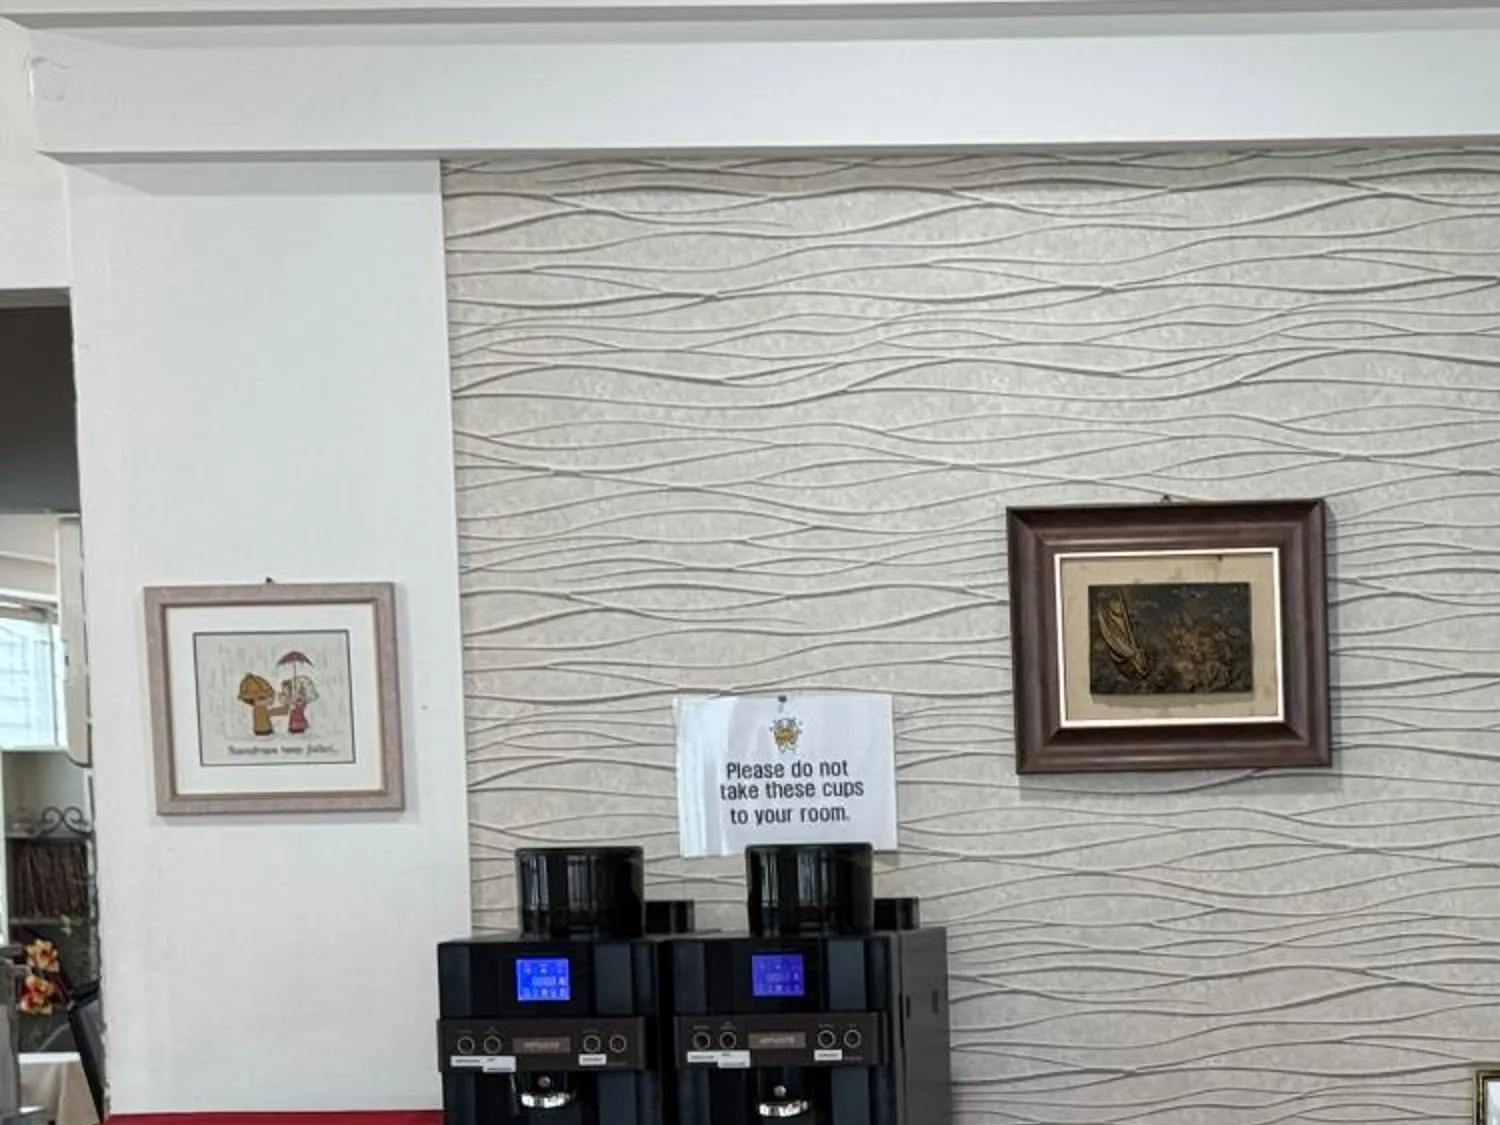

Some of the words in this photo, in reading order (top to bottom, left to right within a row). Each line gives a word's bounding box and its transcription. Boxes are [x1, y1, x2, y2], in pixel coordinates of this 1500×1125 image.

[726, 761, 785, 780] Please
[791, 760, 813, 778] do
[819, 759, 849, 777] not
[720, 782, 760, 800] take
[765, 781, 816, 799] these
[822, 780, 865, 799] cups
[730, 808, 749, 825] to
[754, 807, 793, 826] your
[800, 806, 850, 823] room.
